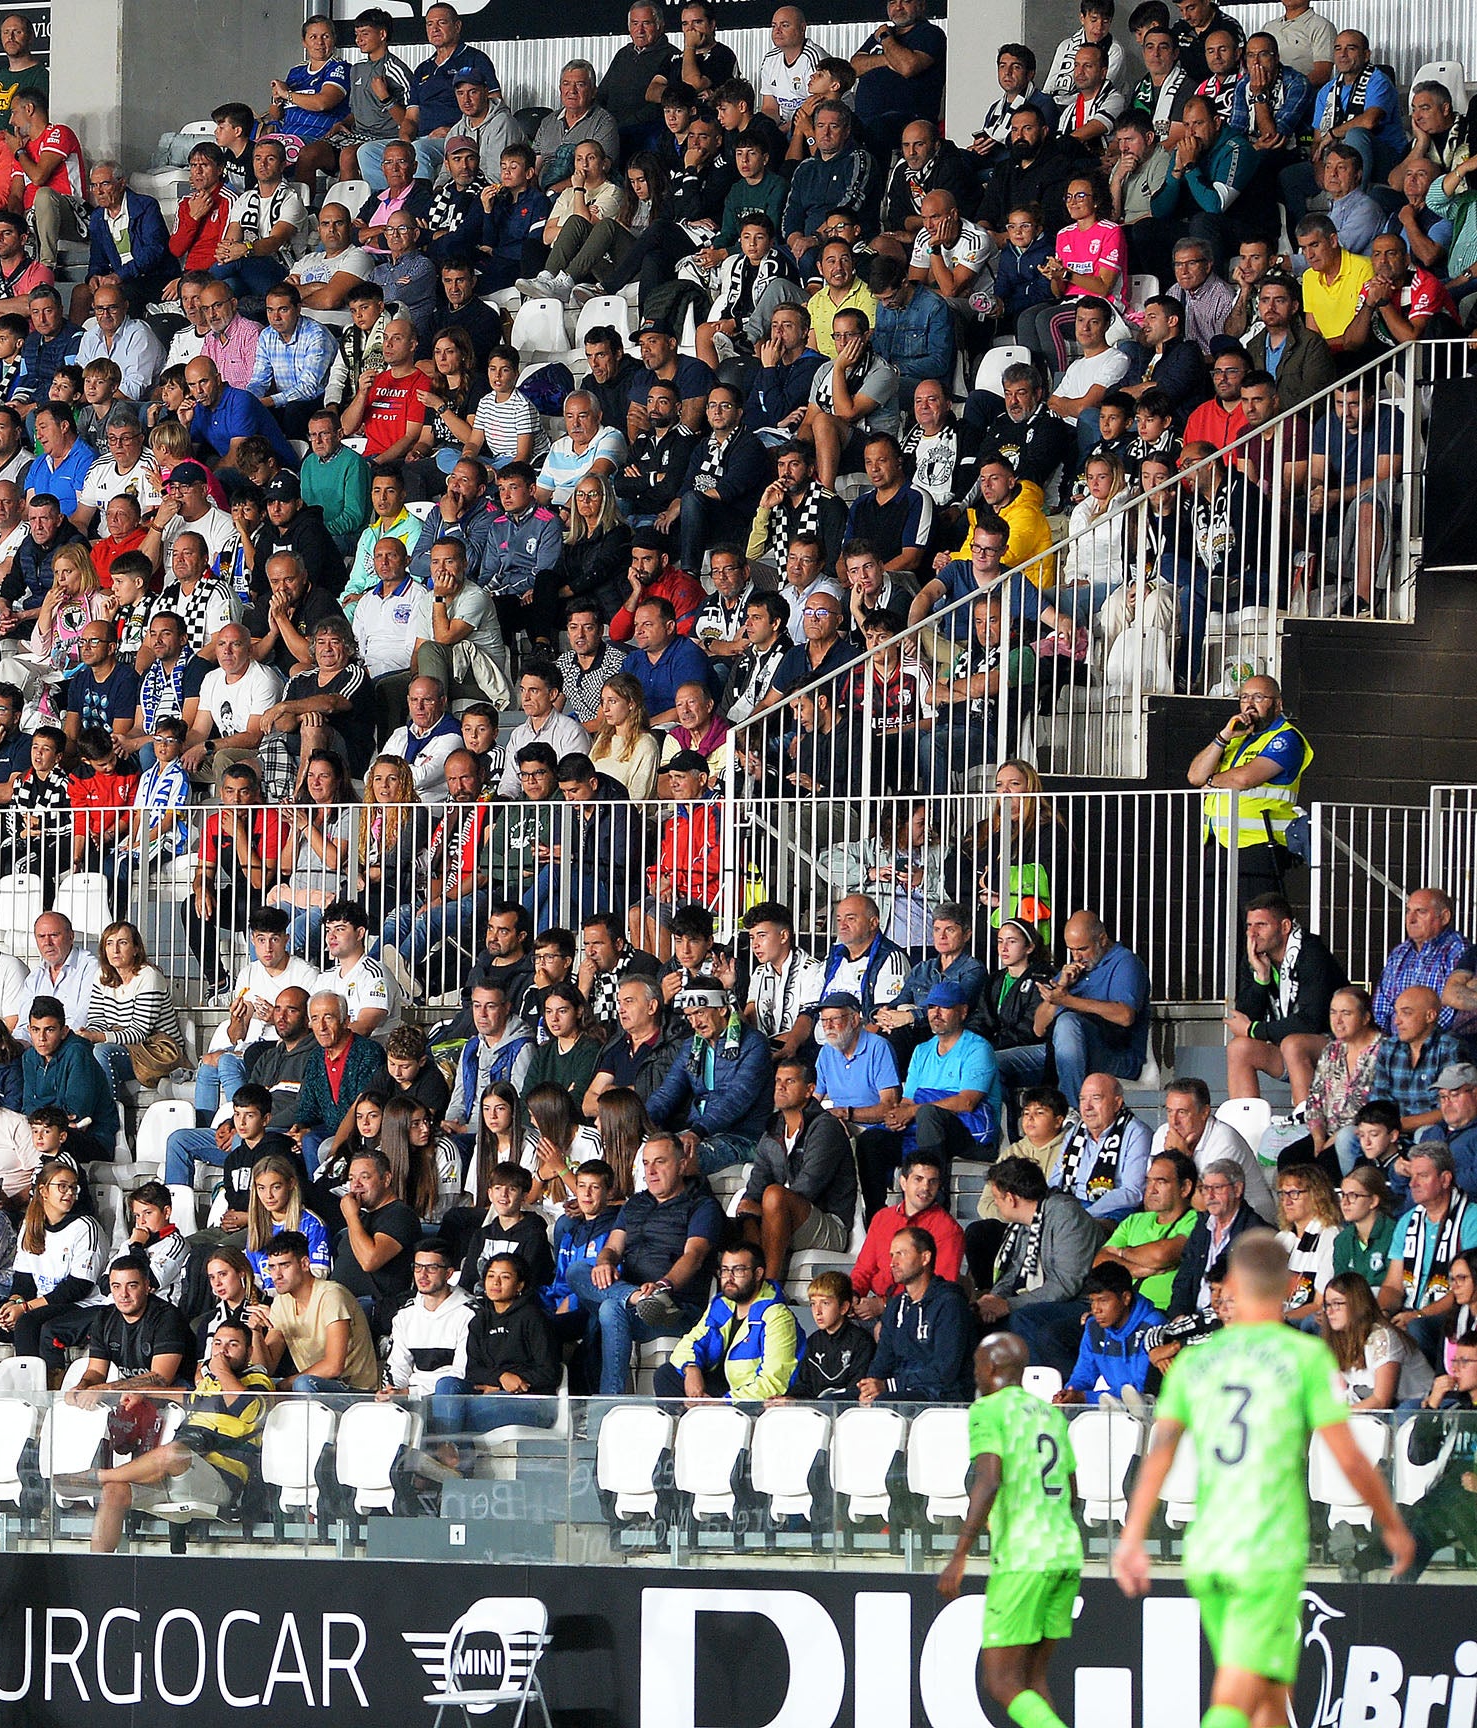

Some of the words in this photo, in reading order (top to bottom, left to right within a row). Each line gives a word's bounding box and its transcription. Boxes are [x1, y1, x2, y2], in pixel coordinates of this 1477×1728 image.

[375, 386, 409, 398] TOMMY
[1214, 1385, 1250, 1465] 3
[1035, 1434, 1063, 1497] 2
[455, 1648, 502, 1676] MINI
